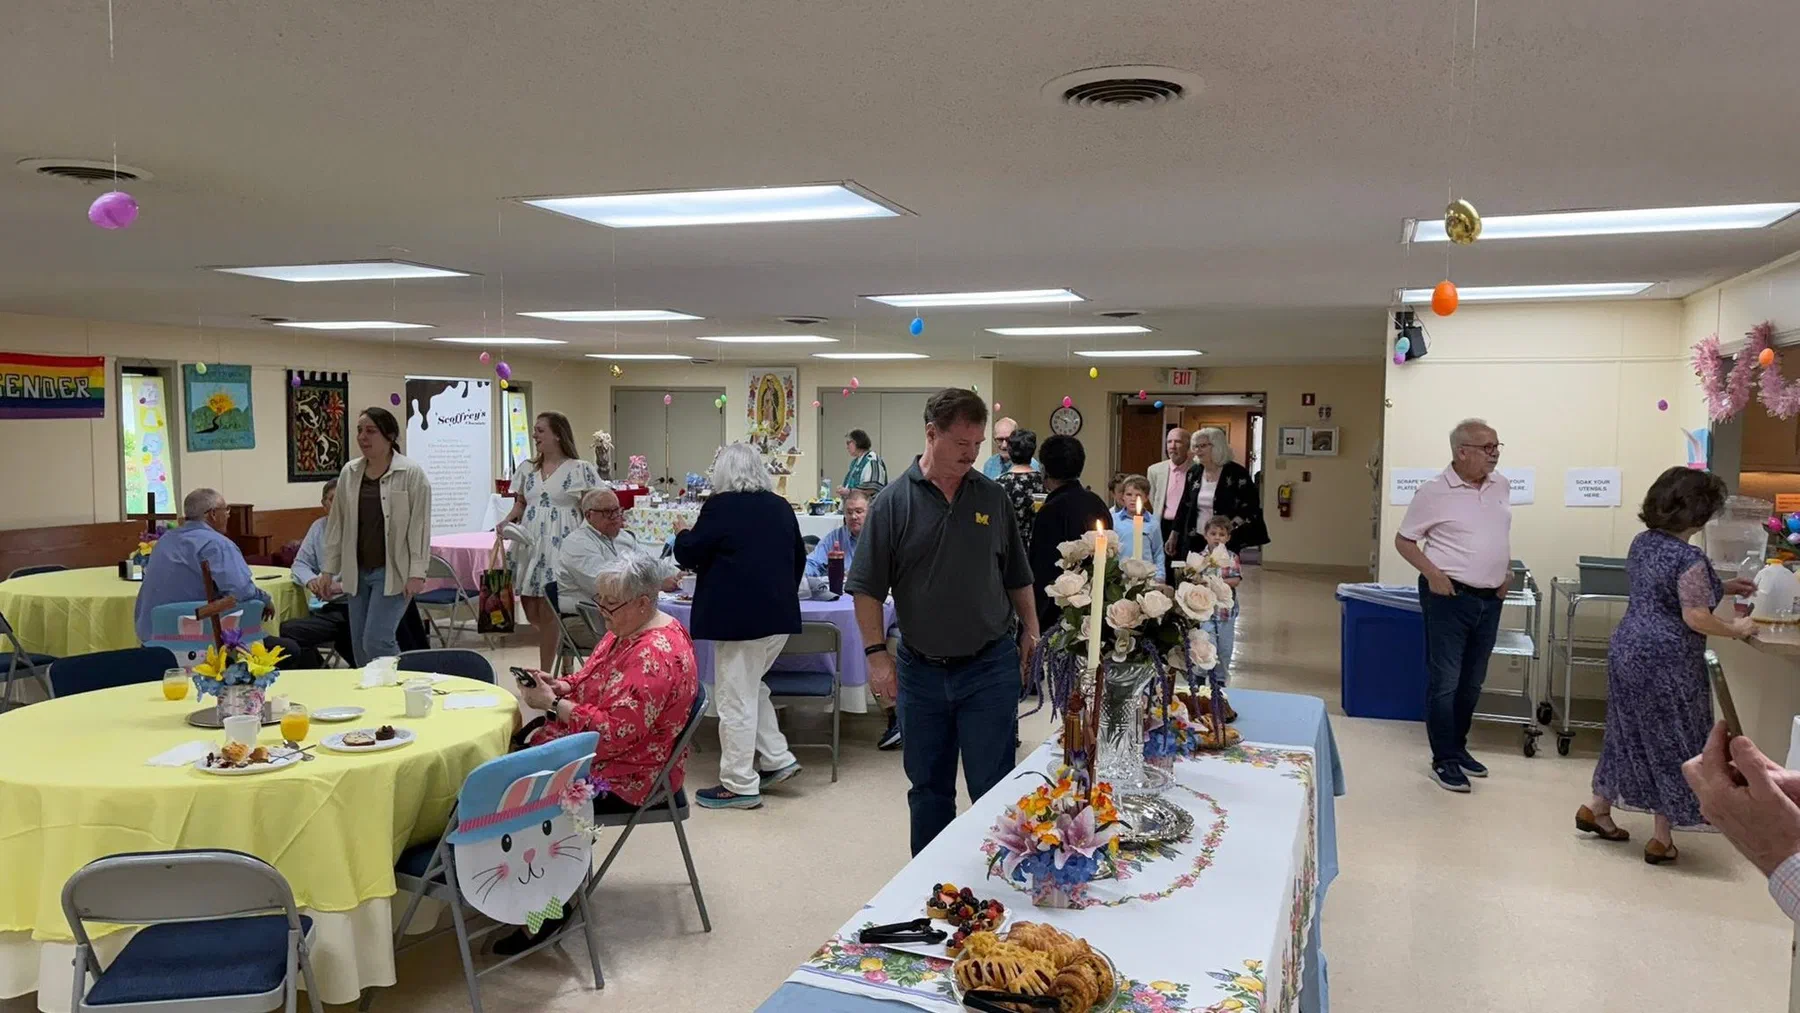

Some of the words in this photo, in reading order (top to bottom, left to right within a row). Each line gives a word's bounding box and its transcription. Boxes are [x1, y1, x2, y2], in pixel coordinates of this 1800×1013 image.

[1174, 371, 1192, 385] EXIT
[0, 374, 91, 399] ENDER
[975, 511, 990, 526] M
